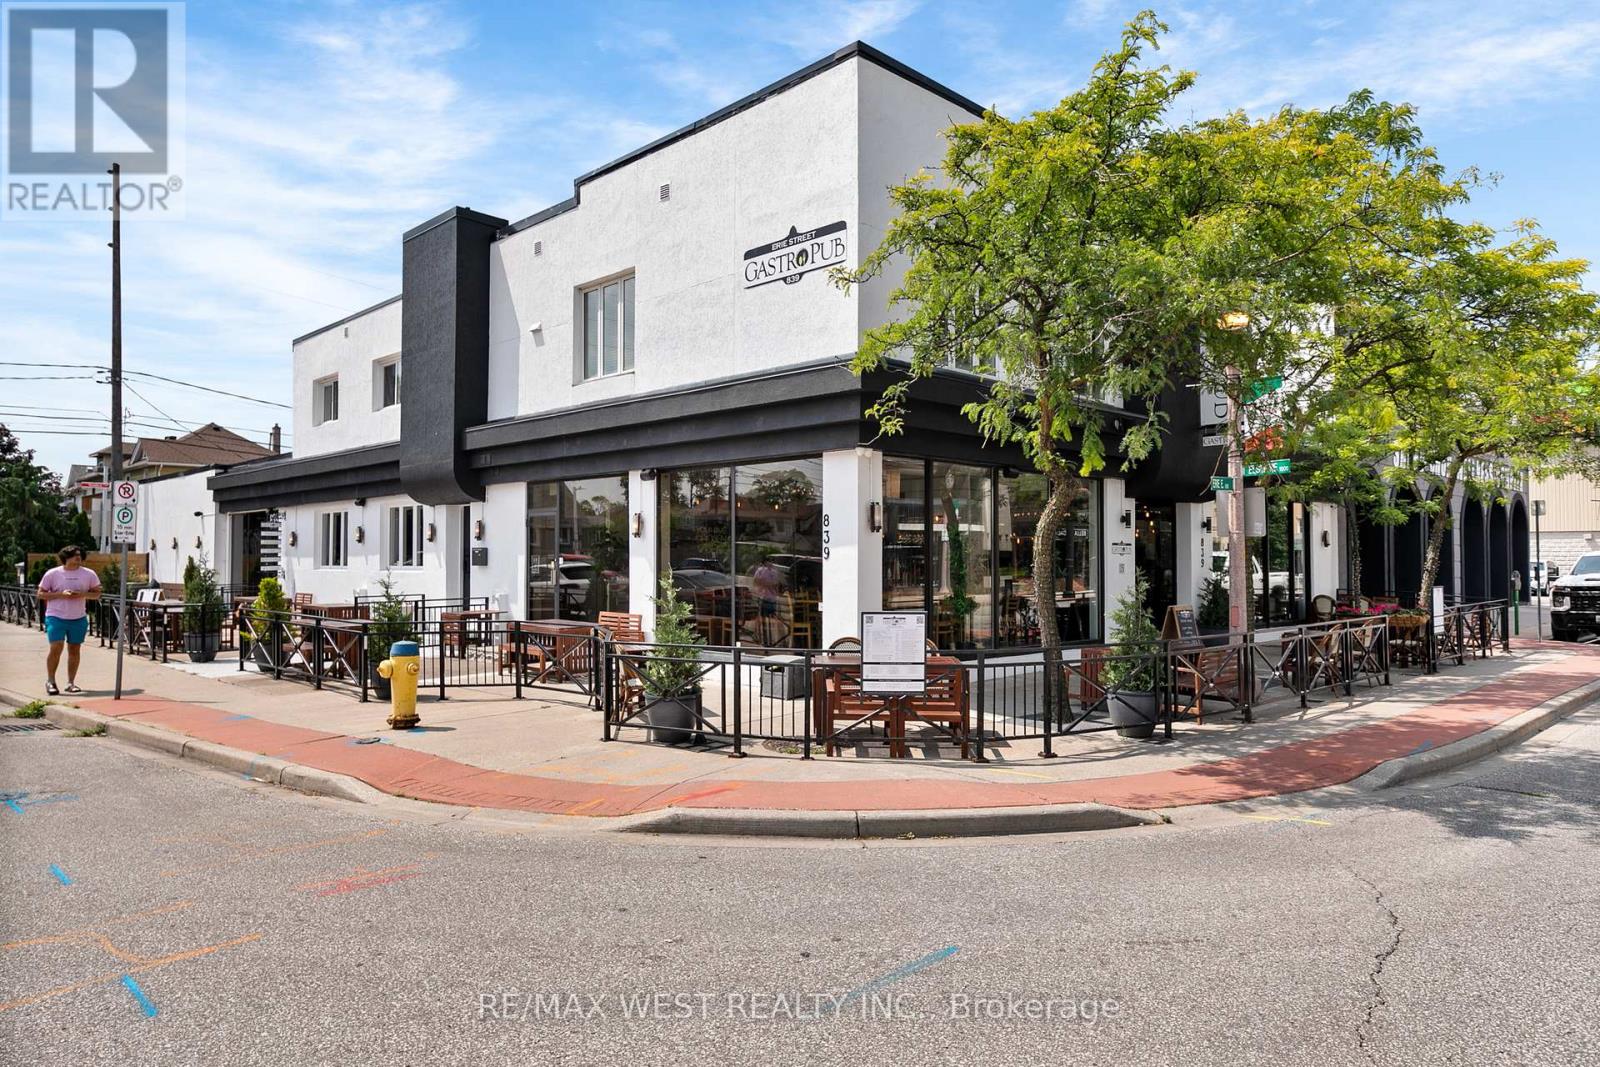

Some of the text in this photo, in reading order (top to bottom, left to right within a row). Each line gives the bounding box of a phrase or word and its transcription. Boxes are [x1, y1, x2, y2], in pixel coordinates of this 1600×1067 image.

[771, 231, 817, 251] ERIE STREET
[744, 237, 846, 282] GASTROPUB
[786, 274, 800, 284] 839
